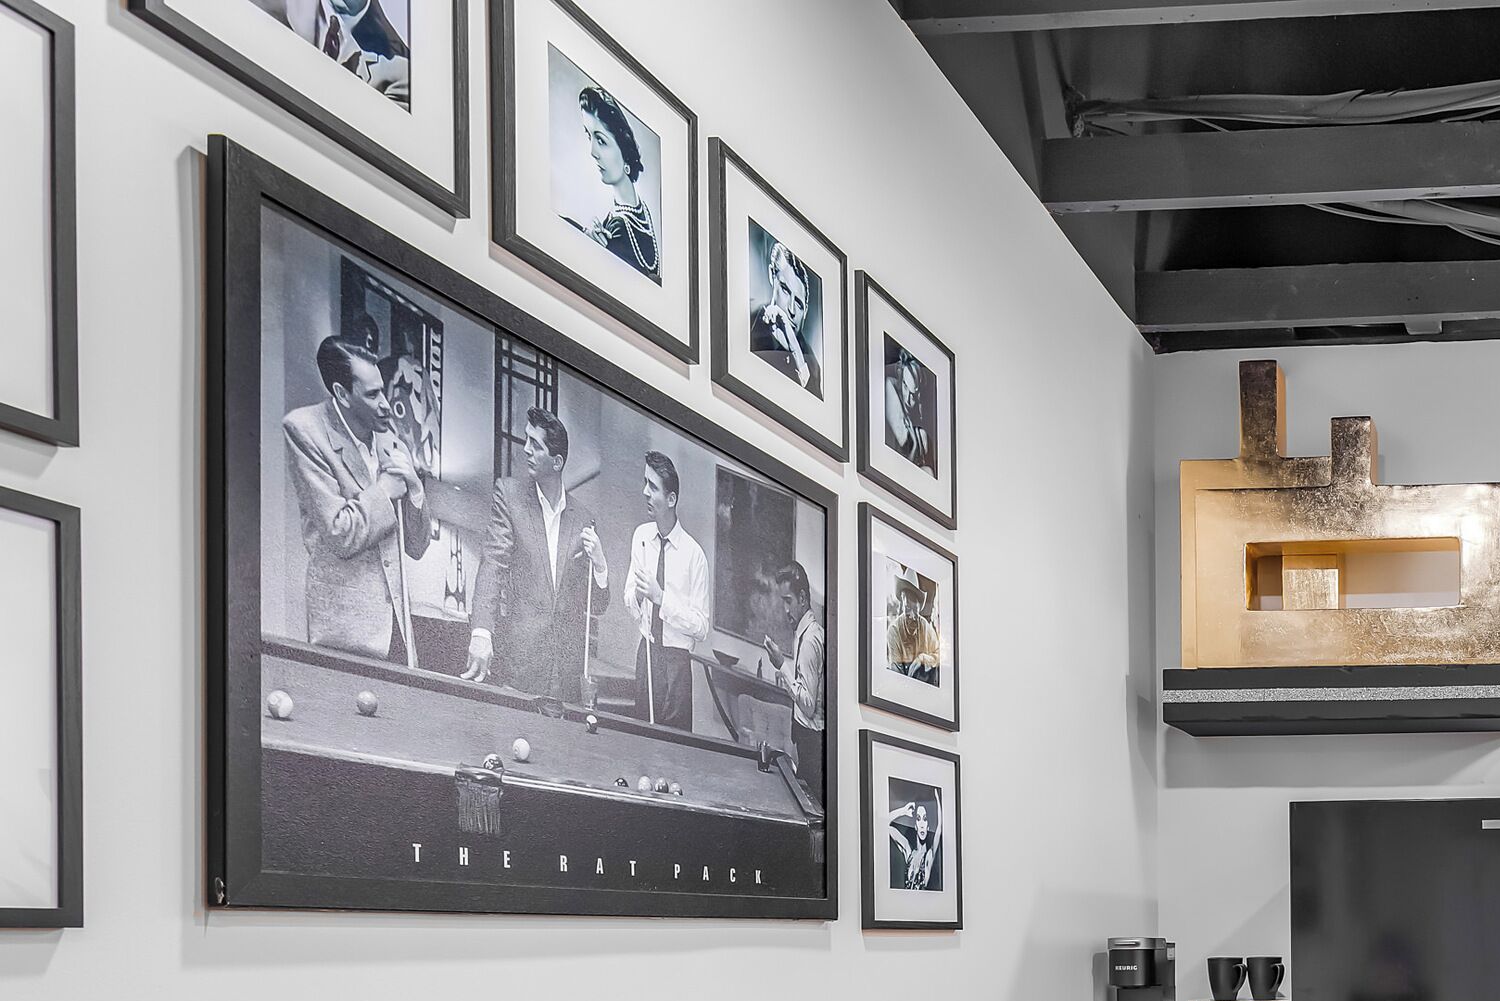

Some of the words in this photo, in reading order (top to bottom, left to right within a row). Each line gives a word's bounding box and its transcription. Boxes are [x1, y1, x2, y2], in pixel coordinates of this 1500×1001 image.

[412, 843, 511, 869] THE
[559, 854, 637, 877] RAT
[674, 863, 762, 884] PACK
